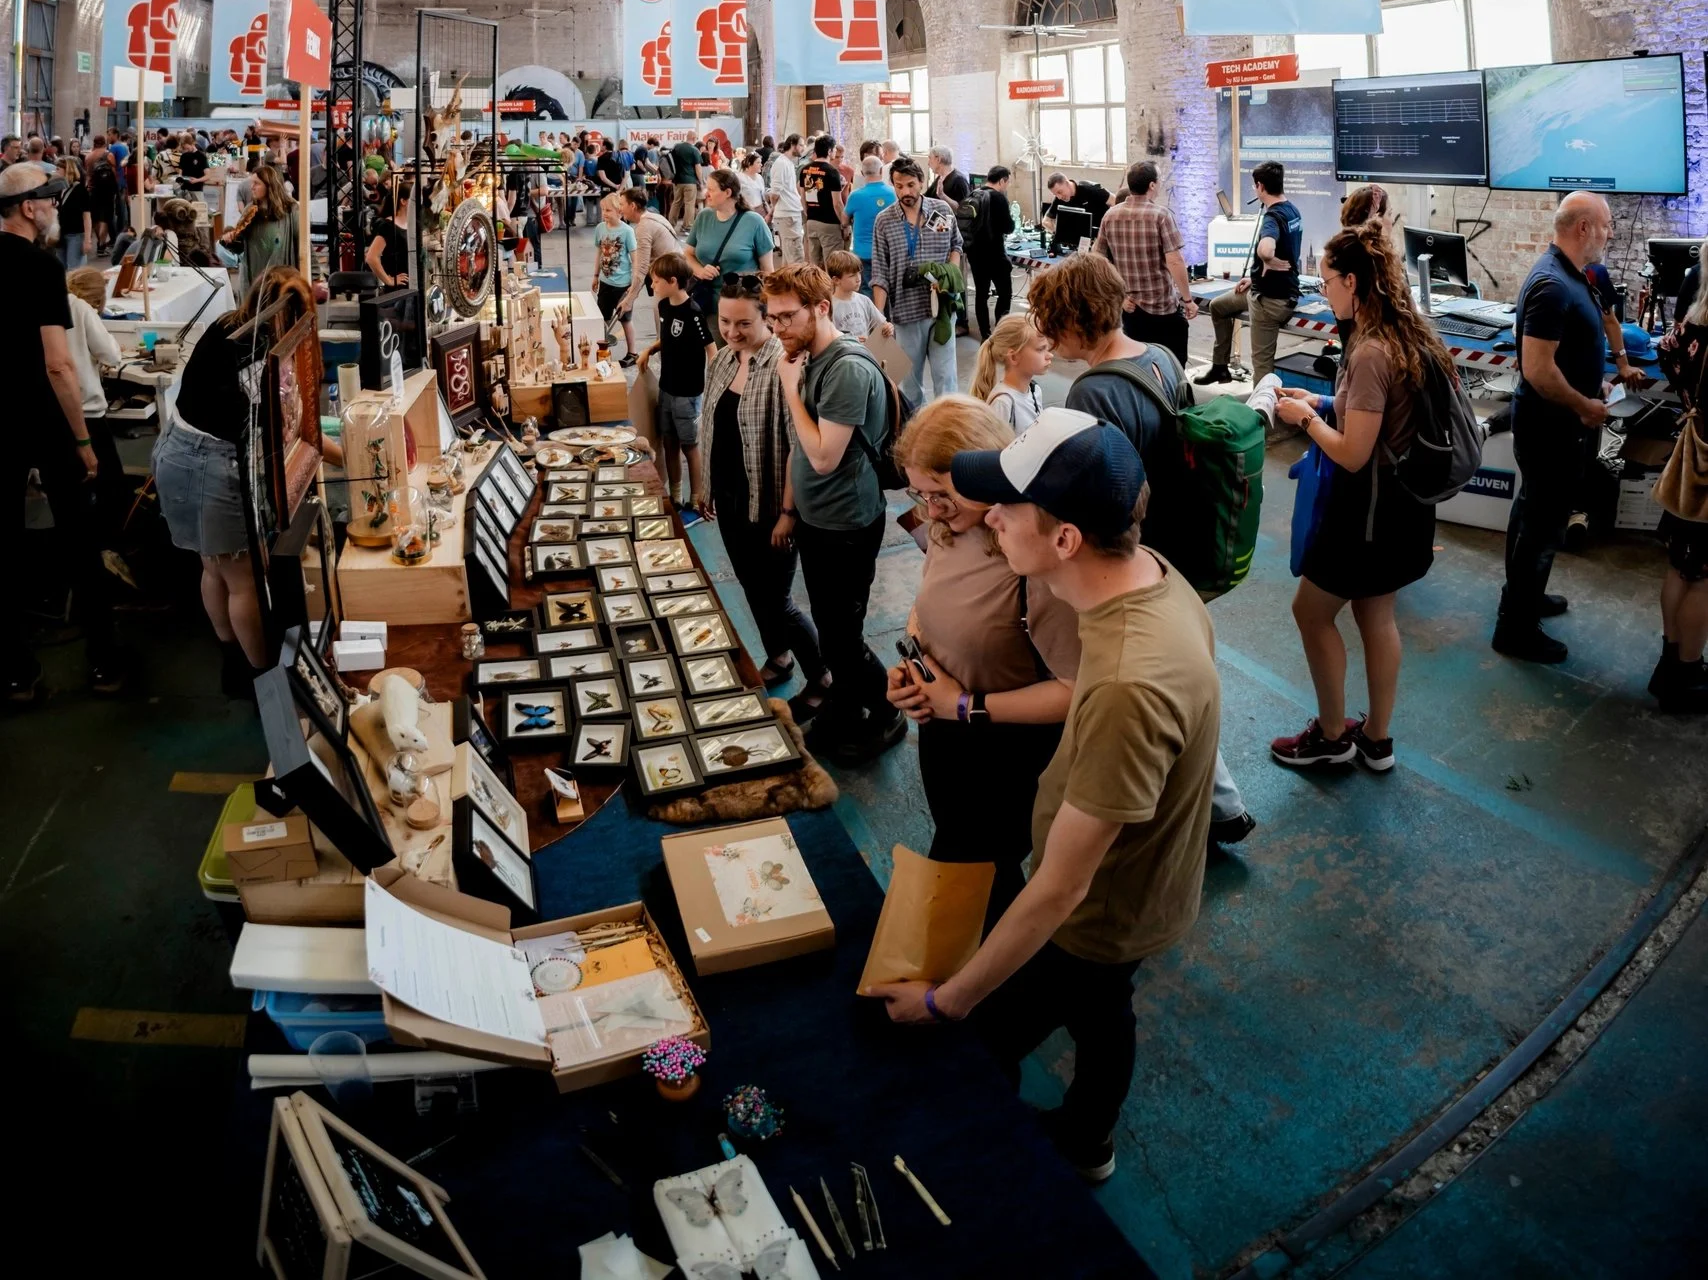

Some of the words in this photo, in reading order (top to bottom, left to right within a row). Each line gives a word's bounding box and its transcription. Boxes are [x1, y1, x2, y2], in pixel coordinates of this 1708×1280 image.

[1221, 64, 1241, 74] TECH
[1242, 59, 1280, 72] ACADEMY
[1262, 73, 1276, 81] Gent
[1016, 84, 1056, 94] RADIOAMATEURS
[630, 131, 664, 141] Maker
[667, 130, 688, 141] Fair
[1216, 247, 1227, 255] KU
[1469, 476, 1509, 491] EUVEN
